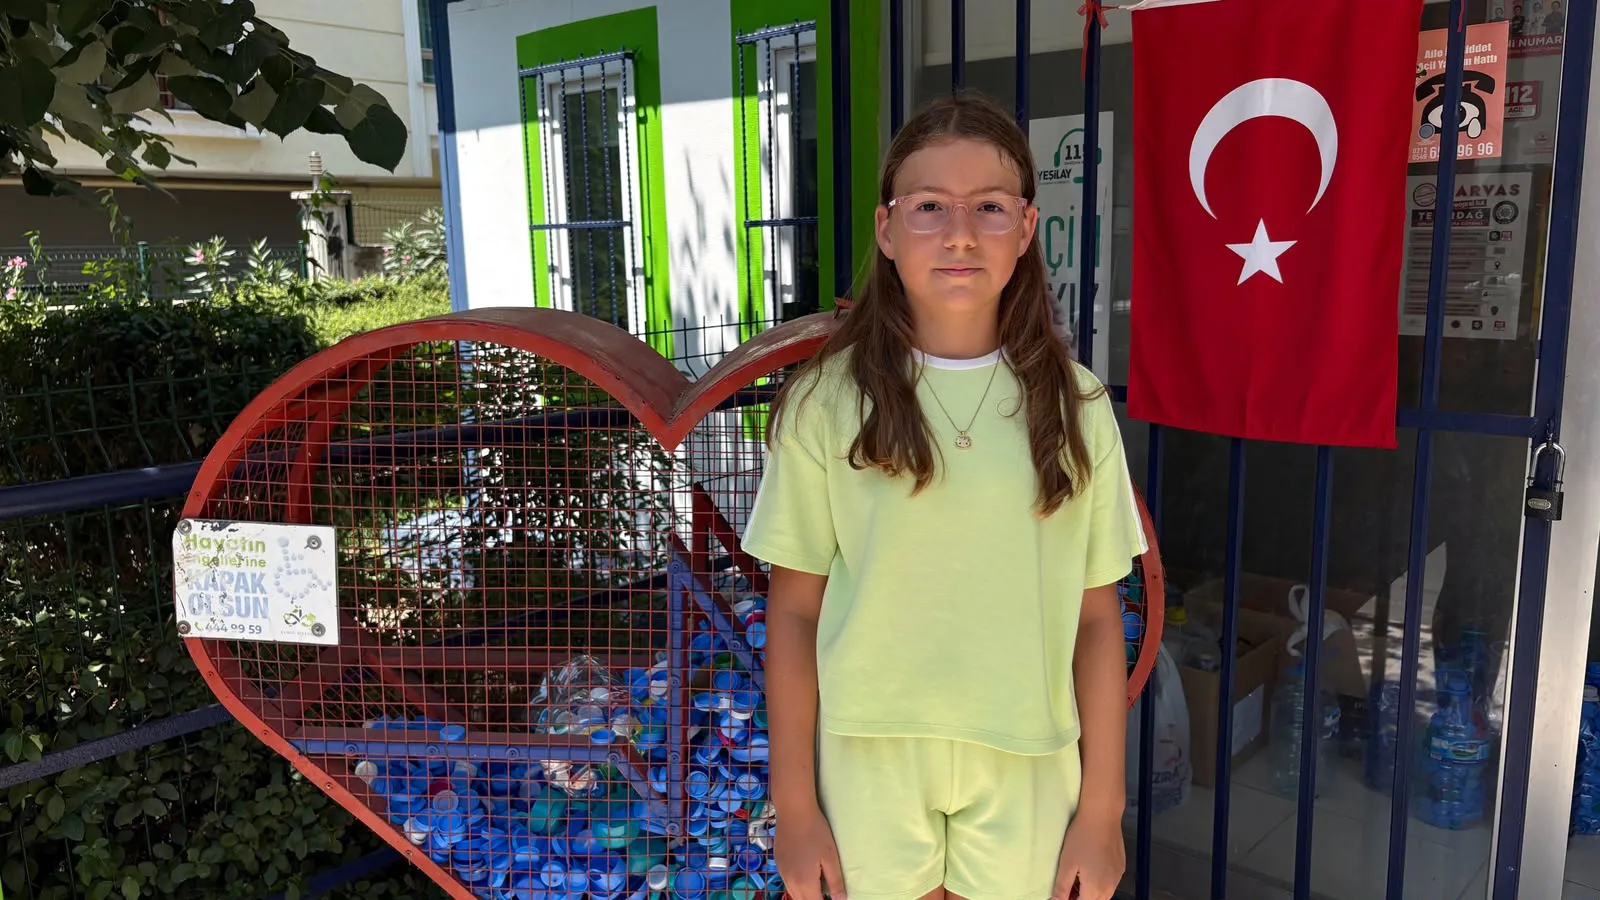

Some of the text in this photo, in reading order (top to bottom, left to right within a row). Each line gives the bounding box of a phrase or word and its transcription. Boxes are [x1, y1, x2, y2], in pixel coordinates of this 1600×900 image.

[1464, 43, 1492, 54] iddet
[1065, 143, 1085, 160] 11
[1477, 142, 1494, 155] 96
[1455, 183, 1521, 197] ARVAS
[248, 625, 262, 634] 59
